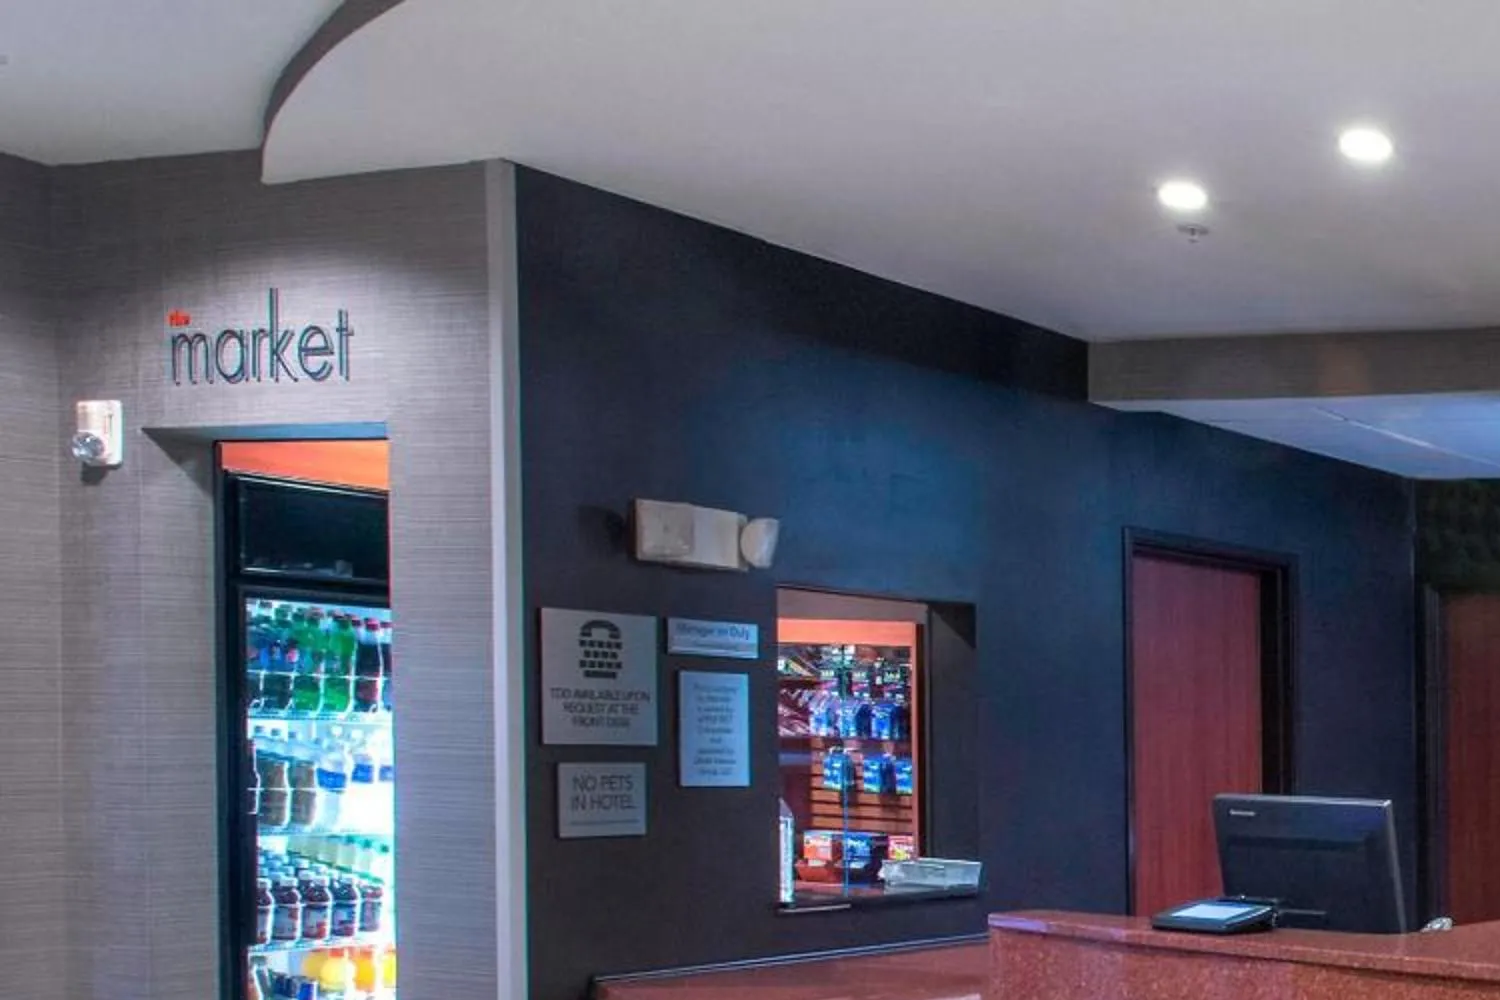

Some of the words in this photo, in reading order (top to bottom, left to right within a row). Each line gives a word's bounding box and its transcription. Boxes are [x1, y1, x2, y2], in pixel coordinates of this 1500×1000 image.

[171, 287, 355, 386] market
[572, 774, 598, 792] NO
[600, 774, 634, 792] PETS
[570, 793, 588, 812] IN
[589, 793, 637, 811] HOTEL
